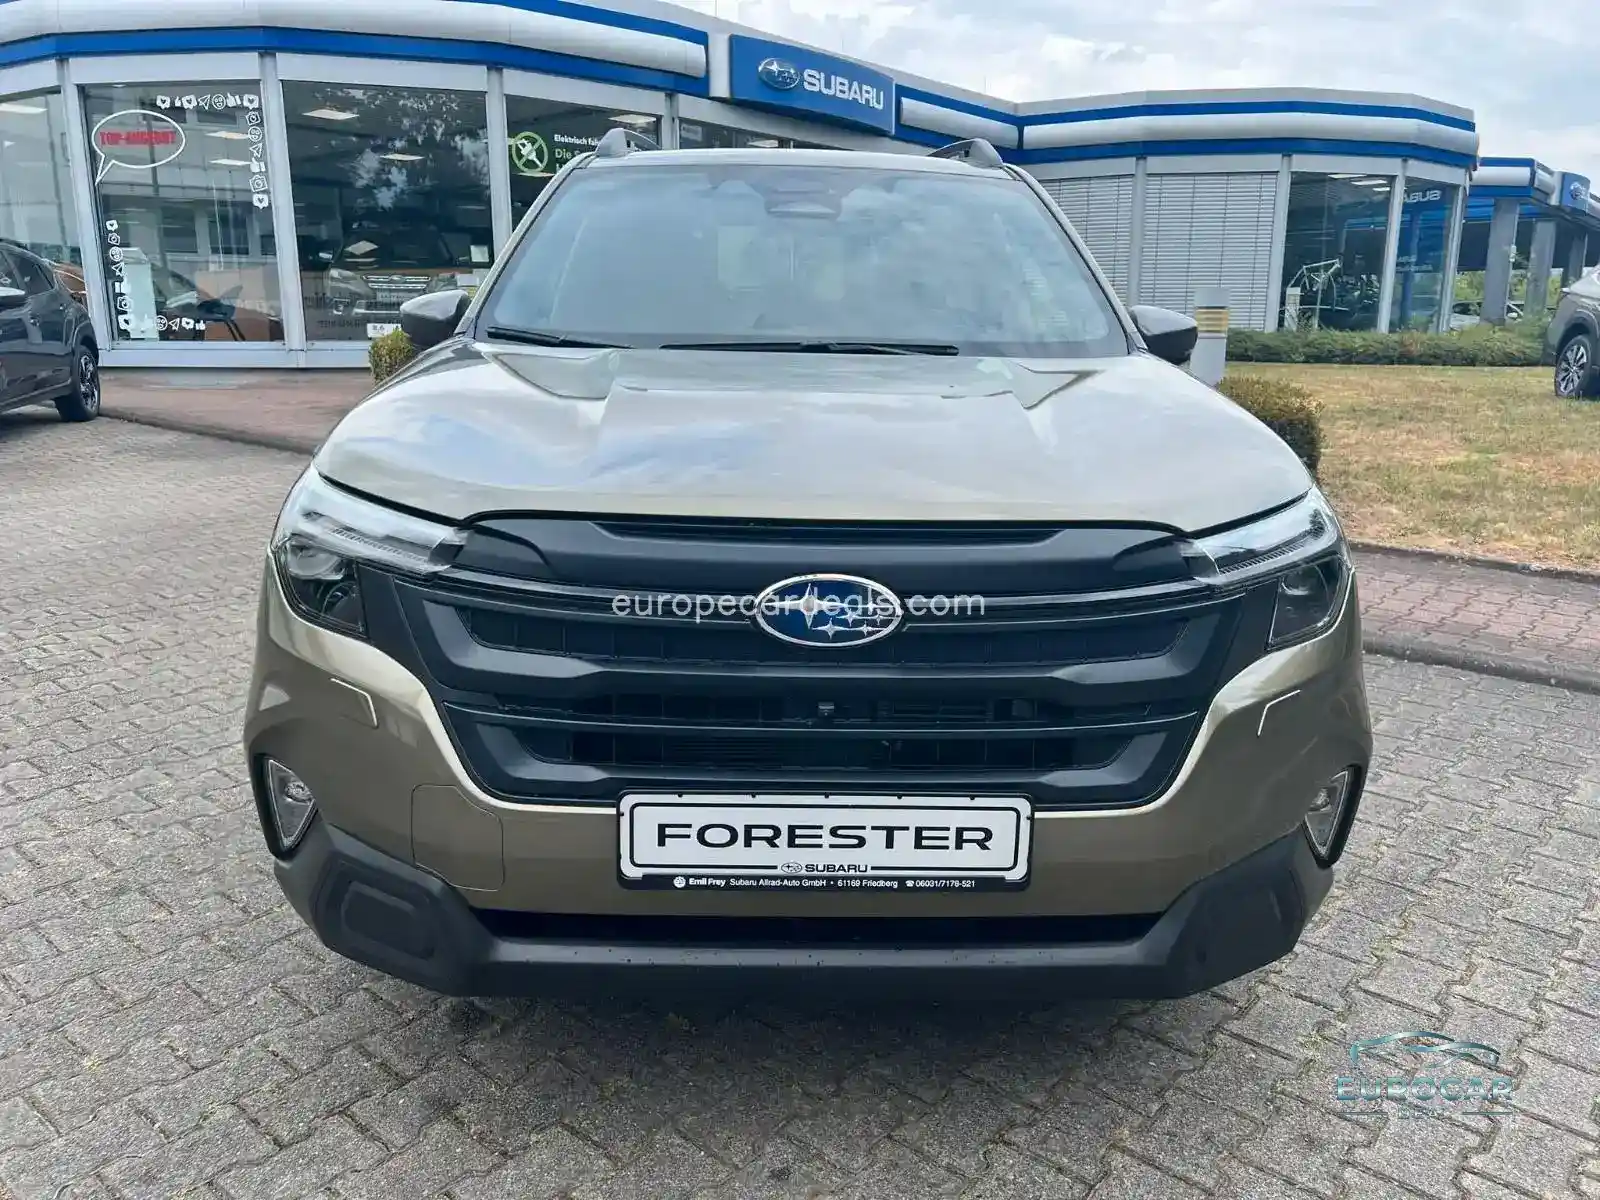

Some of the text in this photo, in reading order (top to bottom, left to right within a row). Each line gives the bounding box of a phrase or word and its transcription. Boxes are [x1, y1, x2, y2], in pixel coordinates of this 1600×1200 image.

[803, 68, 884, 110] SUBARU
[554, 134, 600, 146] Elektrisch fah
[555, 148, 573, 160] Die
[656, 822, 994, 851] FORESTER
[804, 863, 869, 874] SUBARU
[689, 877, 707, 885] Emil
[708, 877, 726, 888] Frey
[729, 878, 757, 886] Subaru
[758, 878, 800, 887] Allrad-Auto
[801, 879, 827, 887] GmbH
[862, 879, 898, 889] Friedberg
